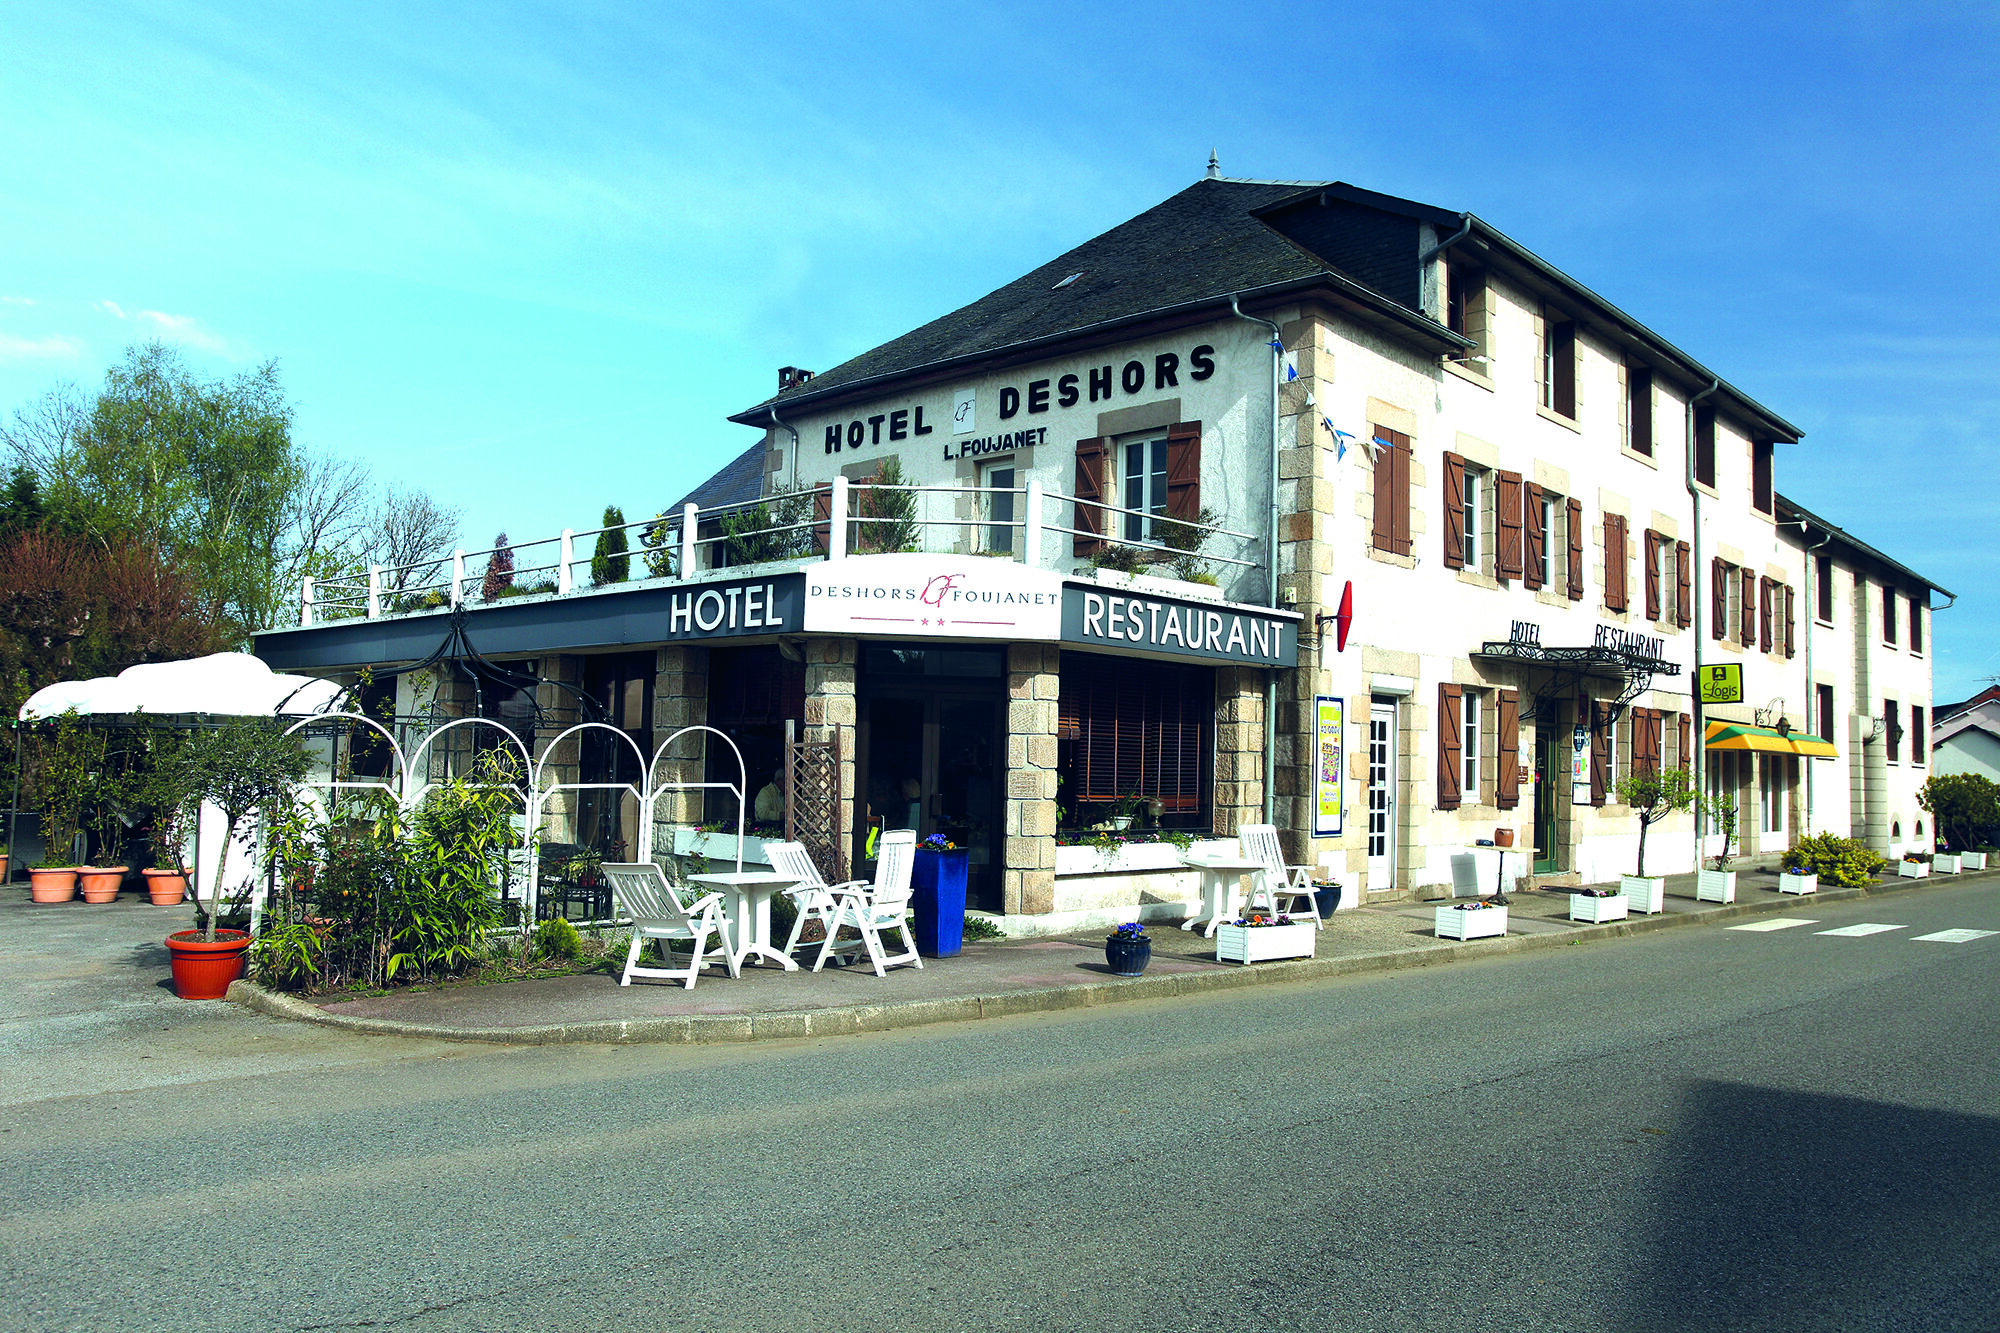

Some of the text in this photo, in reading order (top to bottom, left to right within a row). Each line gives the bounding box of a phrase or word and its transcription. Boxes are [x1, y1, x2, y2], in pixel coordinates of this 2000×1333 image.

[825, 344, 1215, 454] HOTEL DESHORS
[670, 584, 783, 633] HOTEL
[811, 585, 916, 600] DESHORS
[953, 590, 1058, 605] FOUJANET
[1083, 592, 1284, 659] RESTAURANT
[1511, 620, 1665, 660] HOTEL RESTAURANT
[1703, 681, 1738, 700] Logis
